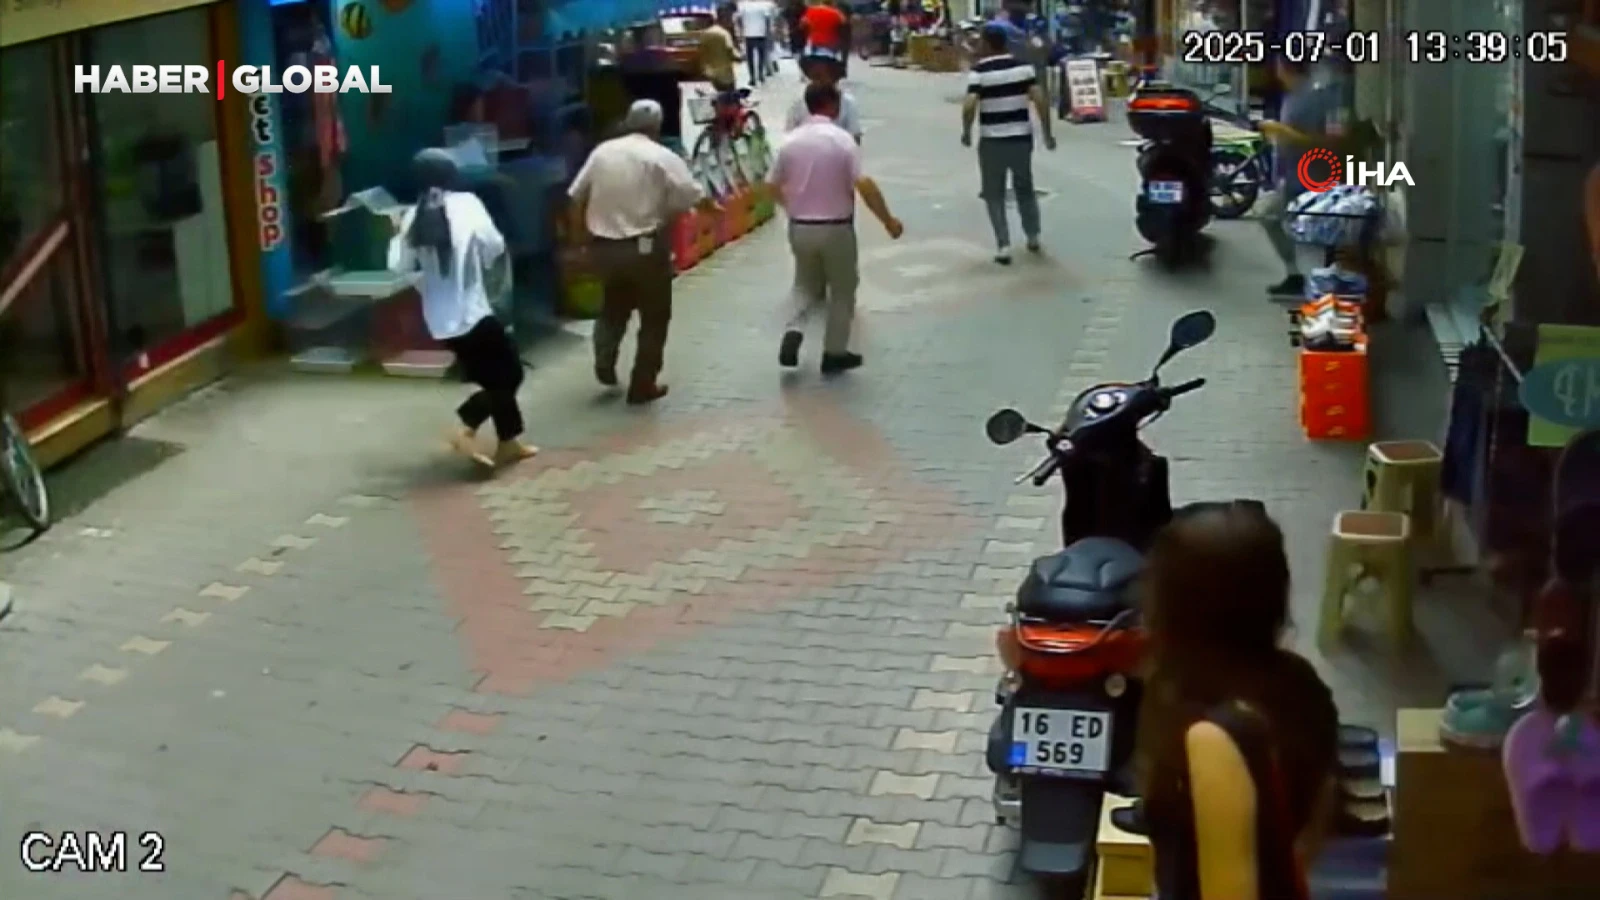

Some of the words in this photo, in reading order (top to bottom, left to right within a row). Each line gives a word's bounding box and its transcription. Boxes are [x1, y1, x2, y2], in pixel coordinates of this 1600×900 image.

[256, 154, 284, 251] shop
[1022, 712, 1049, 735] 16
[1071, 715, 1103, 739] ED
[1036, 740, 1084, 764] 569
